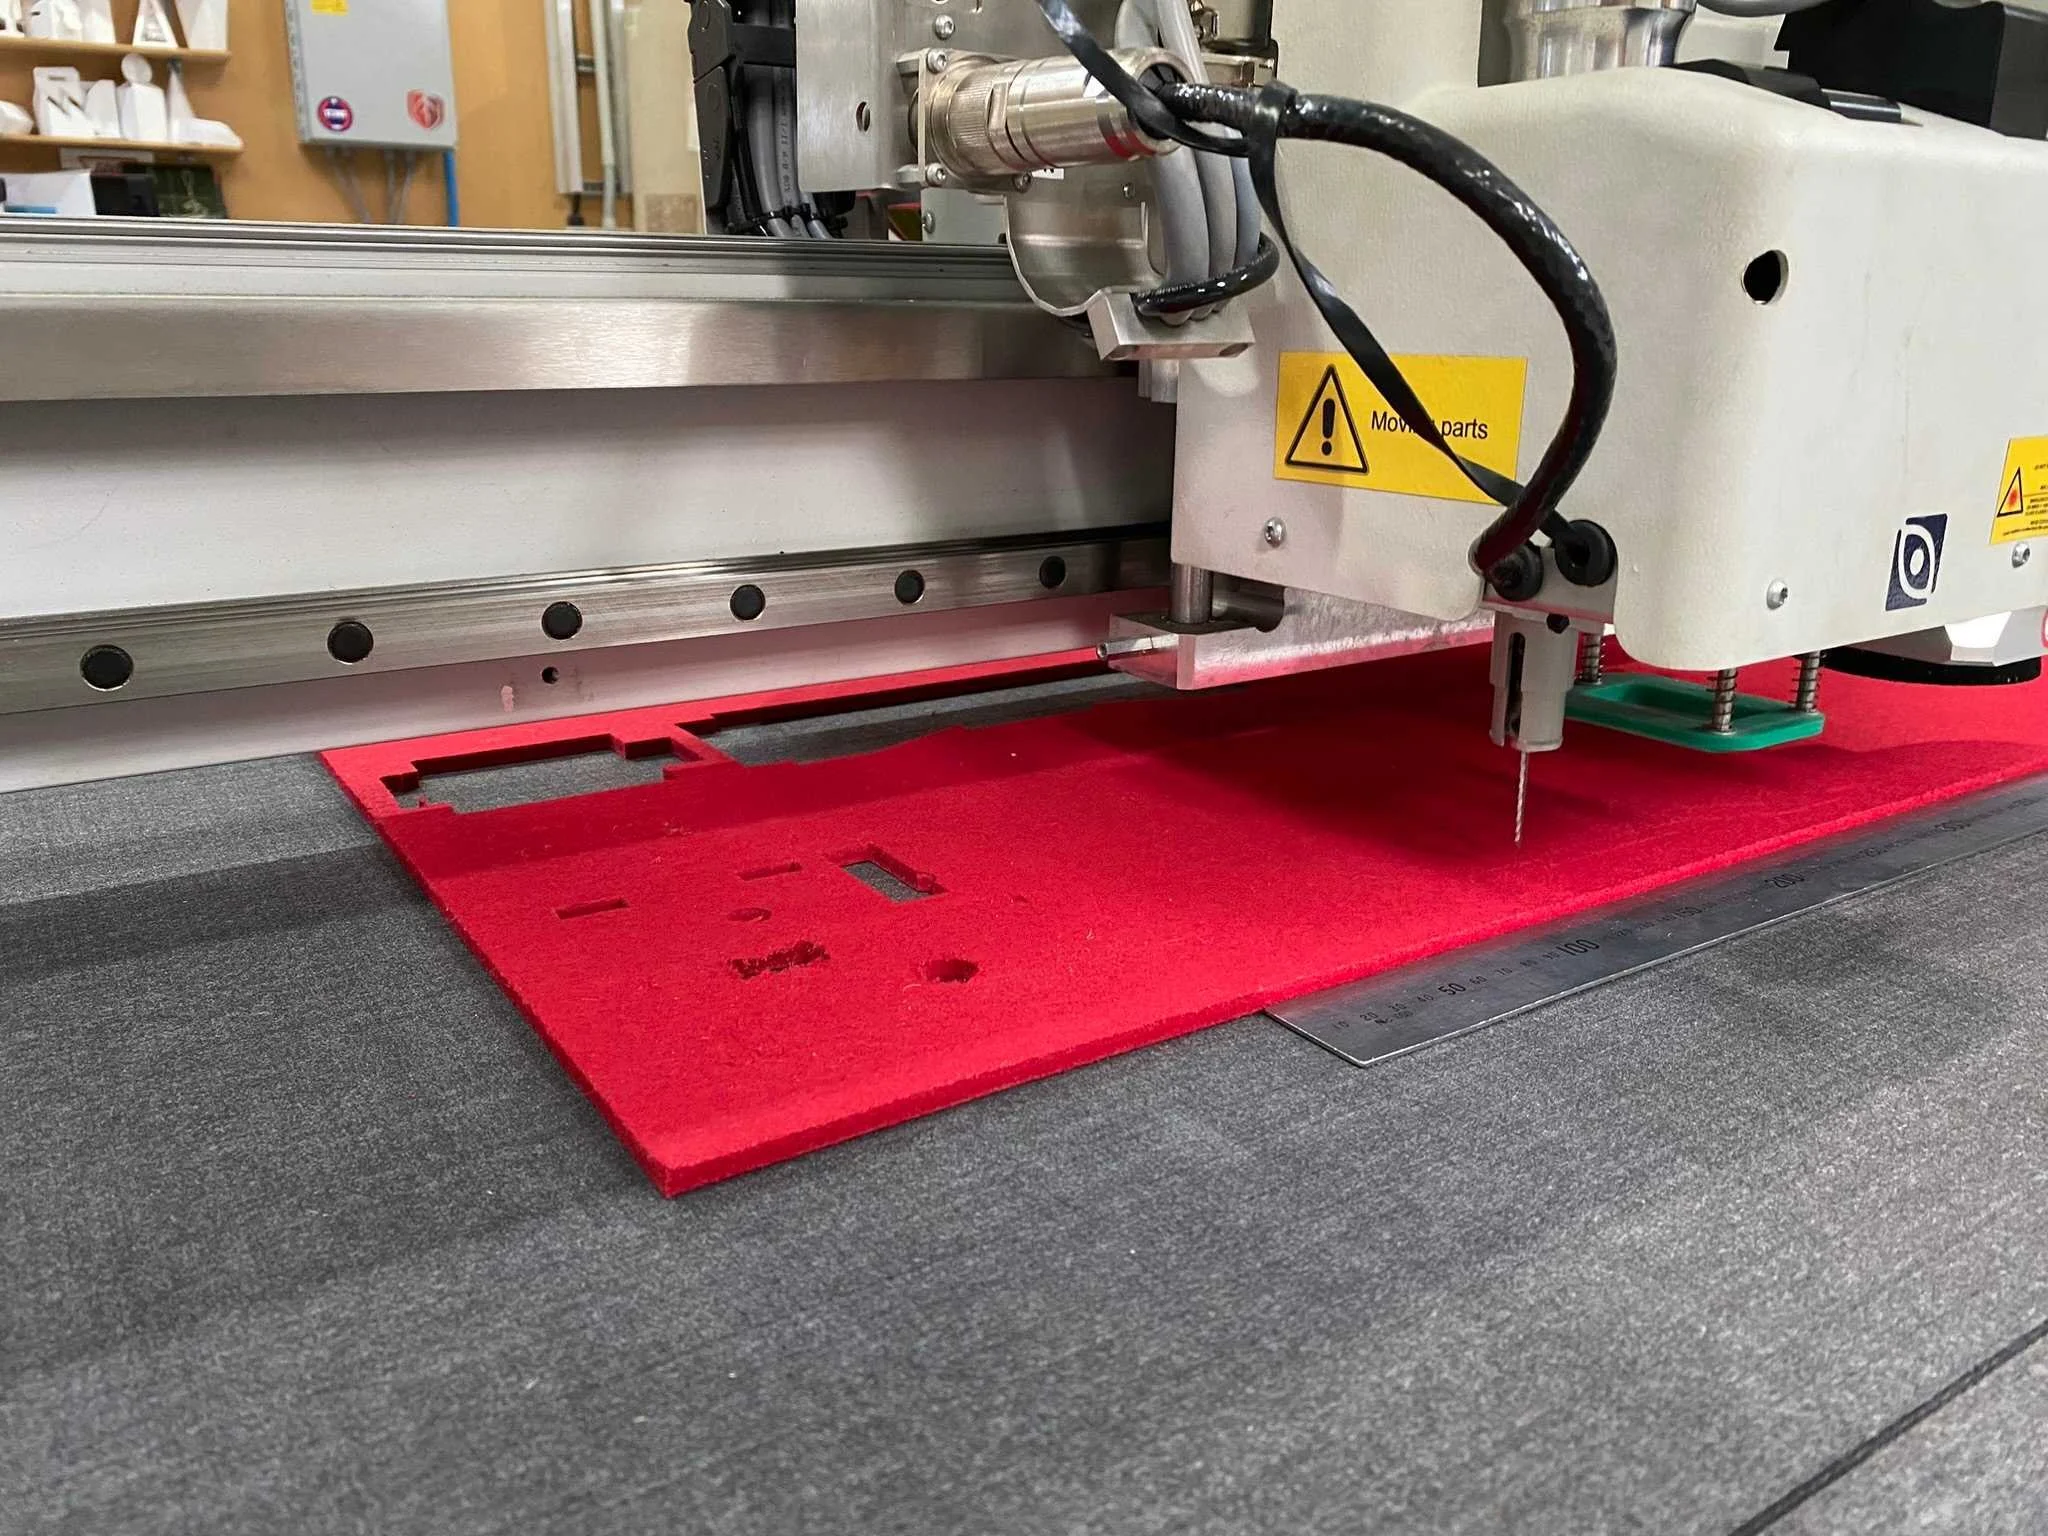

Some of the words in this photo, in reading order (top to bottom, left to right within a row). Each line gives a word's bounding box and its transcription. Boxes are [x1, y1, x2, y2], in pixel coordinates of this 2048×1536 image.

[1371, 410, 1436, 438] Mov
[1441, 418, 1488, 439] parts
[1359, 1011, 1378, 1021] 20
[1438, 982, 1466, 996] 50
[1469, 975, 1487, 985] 60
[1556, 939, 1600, 956] 100
